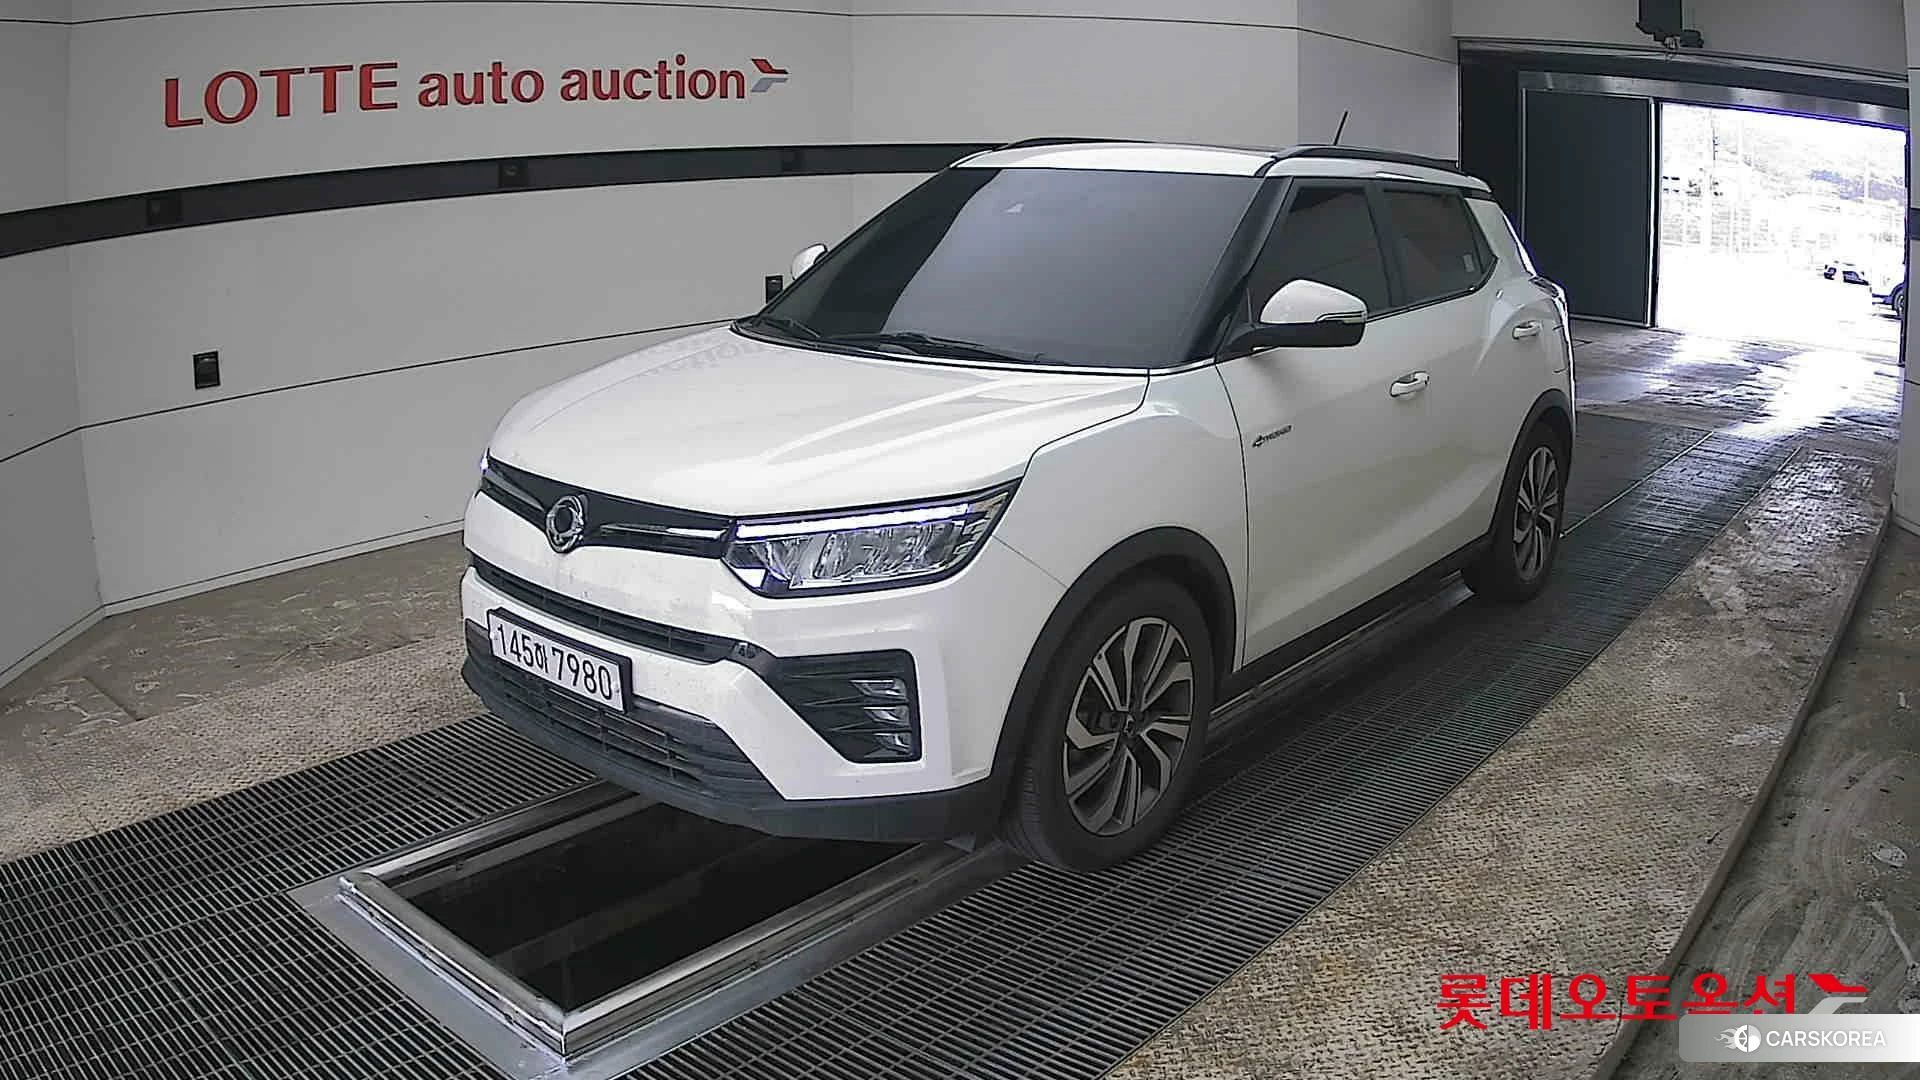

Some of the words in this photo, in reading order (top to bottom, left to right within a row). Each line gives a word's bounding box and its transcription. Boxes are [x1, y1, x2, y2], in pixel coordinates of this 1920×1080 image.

[164, 63, 398, 127] LOTTE
[418, 62, 545, 107] auto
[560, 54, 745, 101] auction
[497, 623, 549, 673] 145하
[552, 646, 613, 700] 7980
